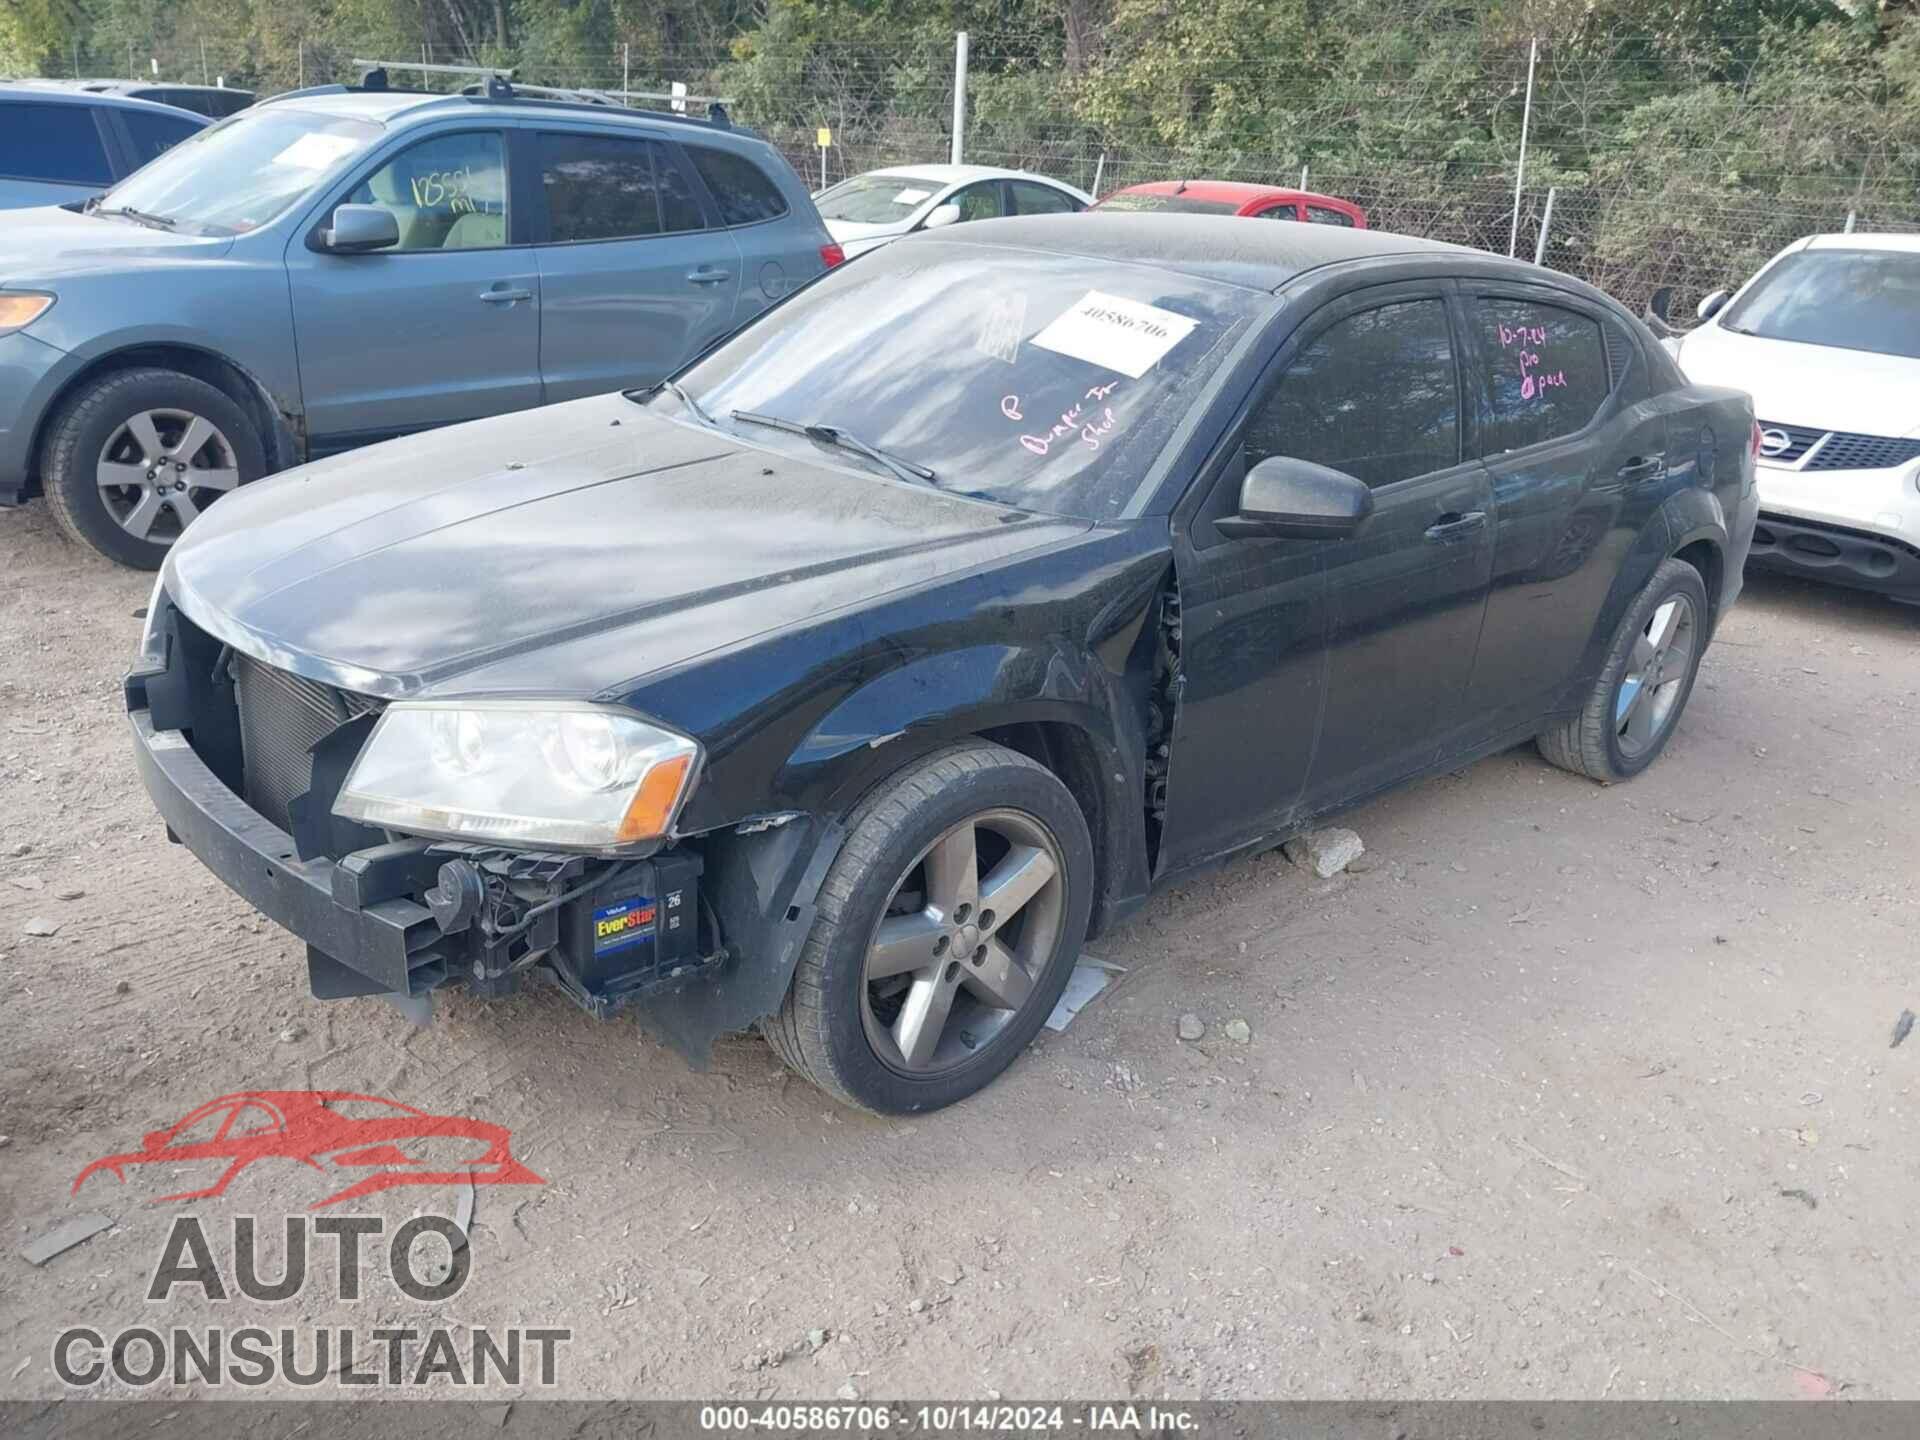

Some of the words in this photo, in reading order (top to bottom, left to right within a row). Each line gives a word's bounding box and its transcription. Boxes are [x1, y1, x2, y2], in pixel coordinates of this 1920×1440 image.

[1082, 306, 1168, 337] 40586706
[667, 894, 681, 909] 26
[598, 908, 656, 937] EverStar
